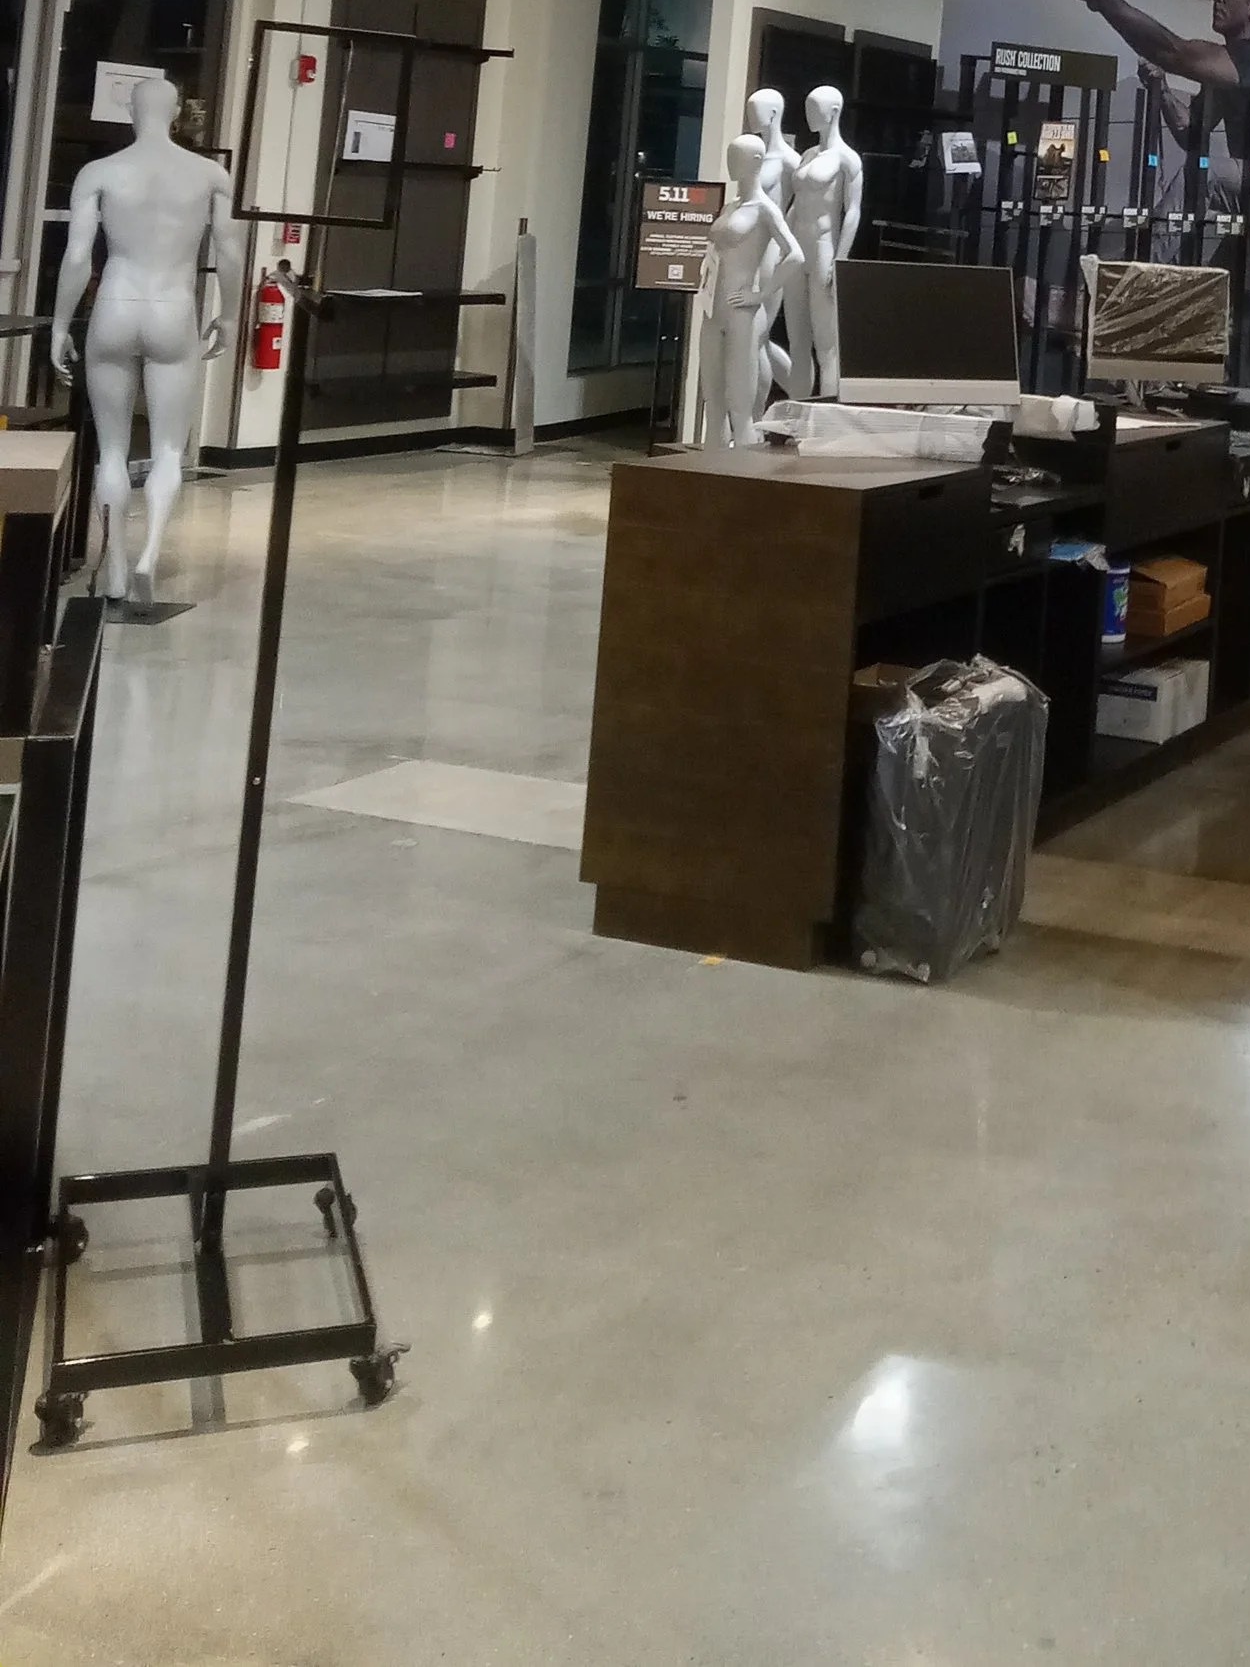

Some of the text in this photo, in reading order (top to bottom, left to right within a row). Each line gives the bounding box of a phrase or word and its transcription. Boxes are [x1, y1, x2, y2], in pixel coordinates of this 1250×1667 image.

[995, 48, 1017, 67] RUSH
[1017, 51, 1061, 72] COLLECTION
[659, 185, 690, 203] 5.11
[647, 210, 713, 223] WE'RE HIRING
